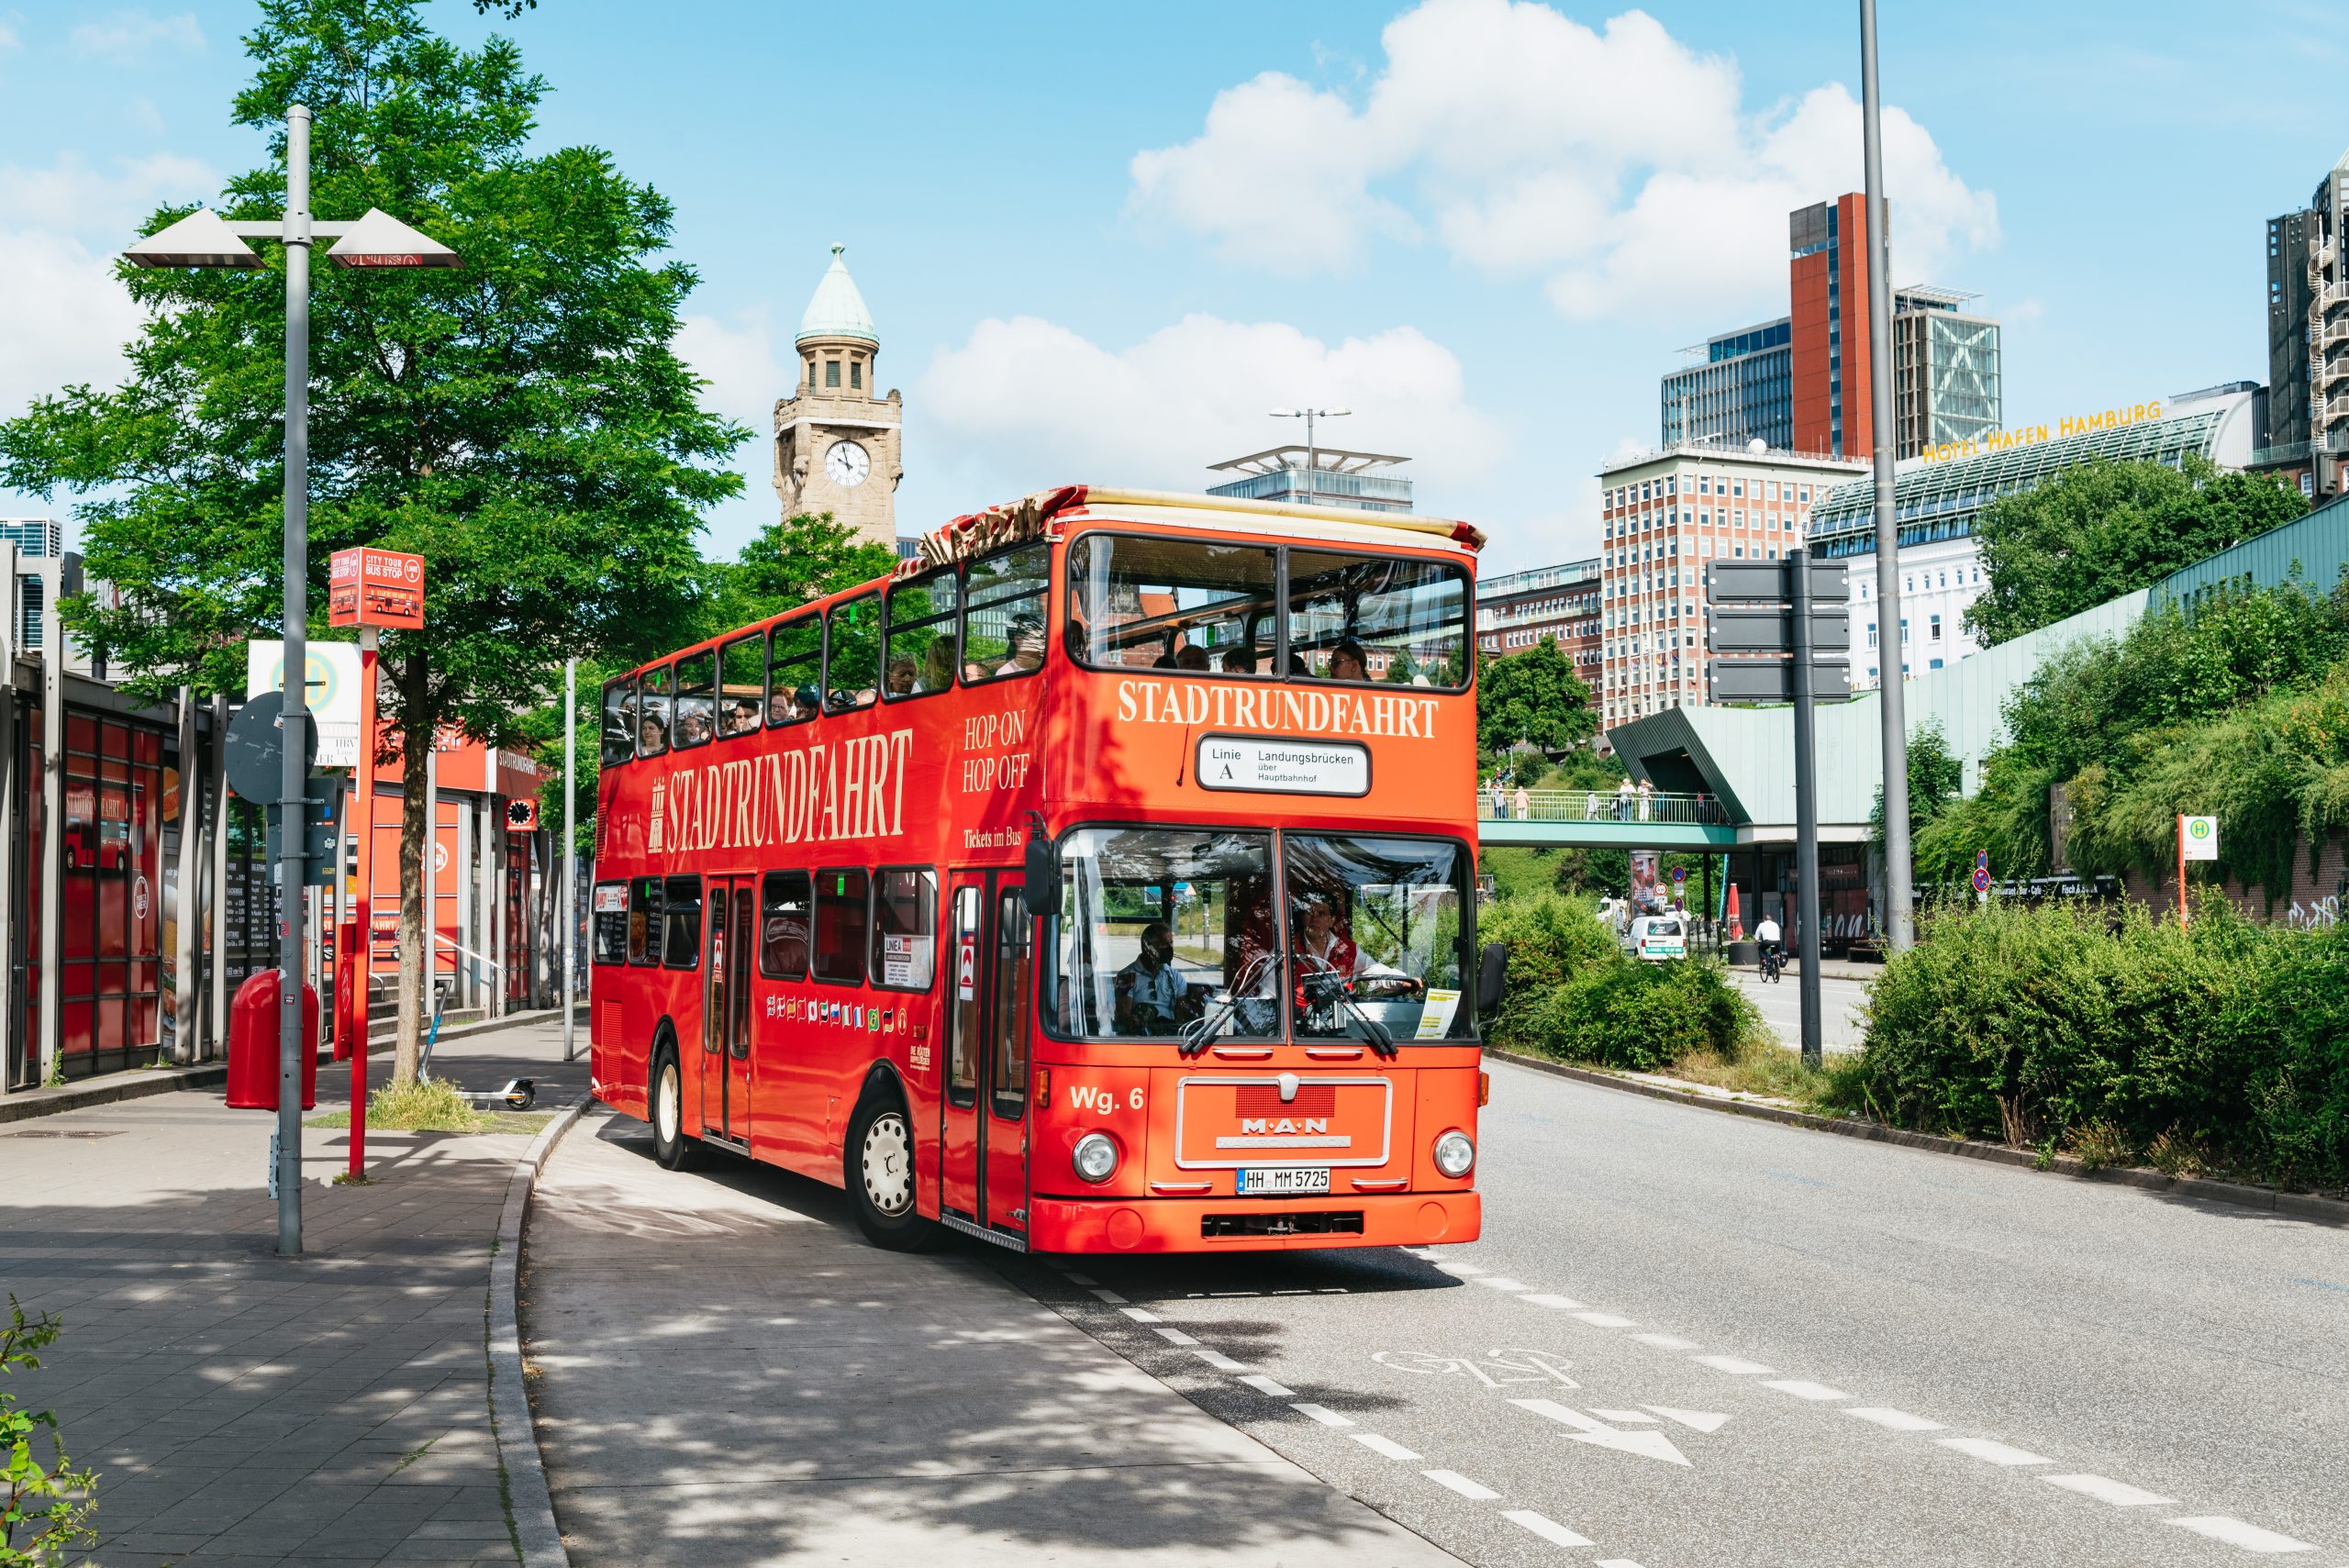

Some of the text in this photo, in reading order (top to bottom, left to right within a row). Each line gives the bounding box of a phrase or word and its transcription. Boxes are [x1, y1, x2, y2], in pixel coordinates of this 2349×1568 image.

[1922, 401, 2161, 464] HOTEL HAFEN HAMBURG
[366, 554, 402, 568] CITY TOUR
[406, 565, 418, 573] LINIE
[365, 565, 403, 579] BUS STOP
[1118, 679, 1440, 739] STADTRUNDFAHRT
[964, 709, 1027, 751] HOP ON
[498, 750, 537, 776] STADTRUNDFAHRT
[1212, 749, 1241, 760] Linie
[1258, 750, 1353, 765] Landungsbrücken
[962, 753, 1030, 793] HOP OFF
[1219, 763, 1234, 780] A
[1258, 763, 1277, 772] über
[1258, 773, 1317, 783] Hauptbahnhof
[666, 728, 913, 854] STADTRUNDFAHRT
[964, 826, 1021, 848] Tickets im Bus
[2062, 884, 2076, 895] Fisch
[886, 940, 897, 951] LINIE
[1069, 1085, 1144, 1115] Wg. 6
[1246, 1170, 1329, 1188] HH MM 5725
